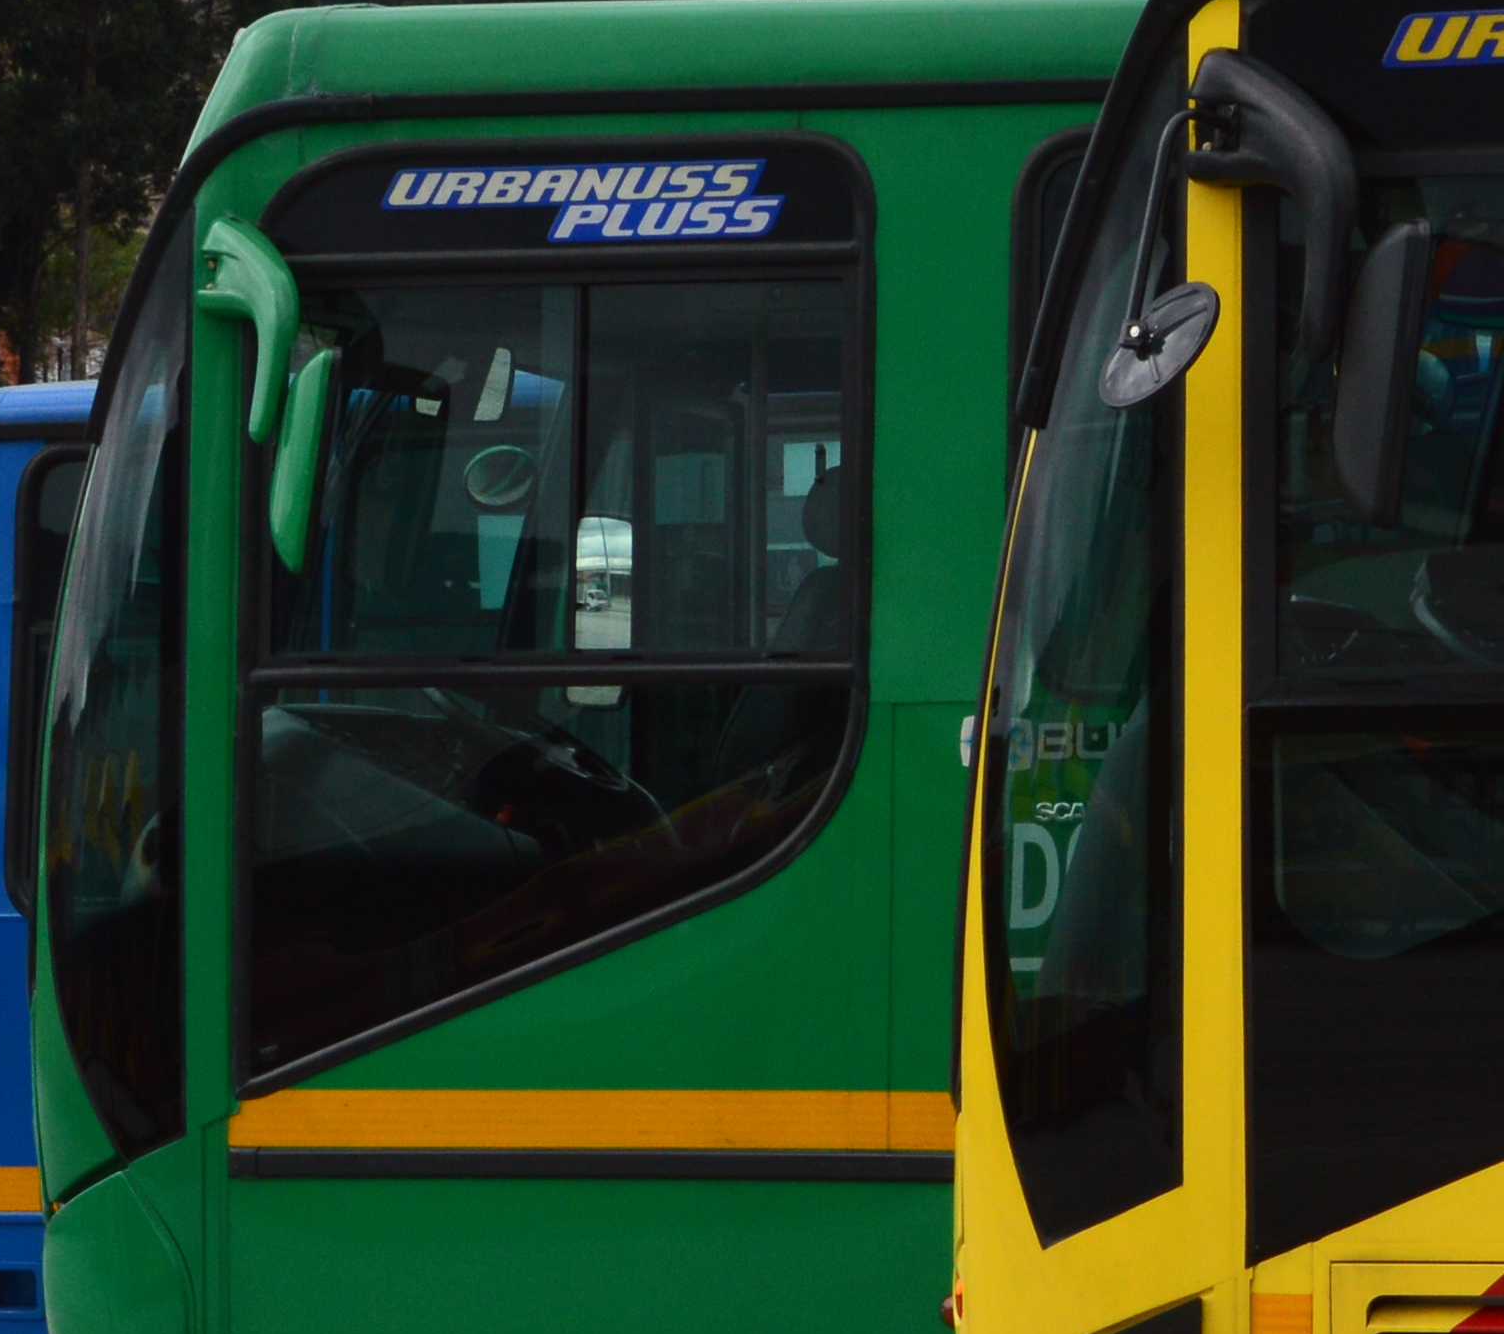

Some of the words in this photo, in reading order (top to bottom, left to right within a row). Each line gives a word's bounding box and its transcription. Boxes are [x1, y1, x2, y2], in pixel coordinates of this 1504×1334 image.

[387, 164, 758, 206] URBANUSS
[553, 199, 779, 239] PLUSS
[1009, 822, 1083, 929] D
